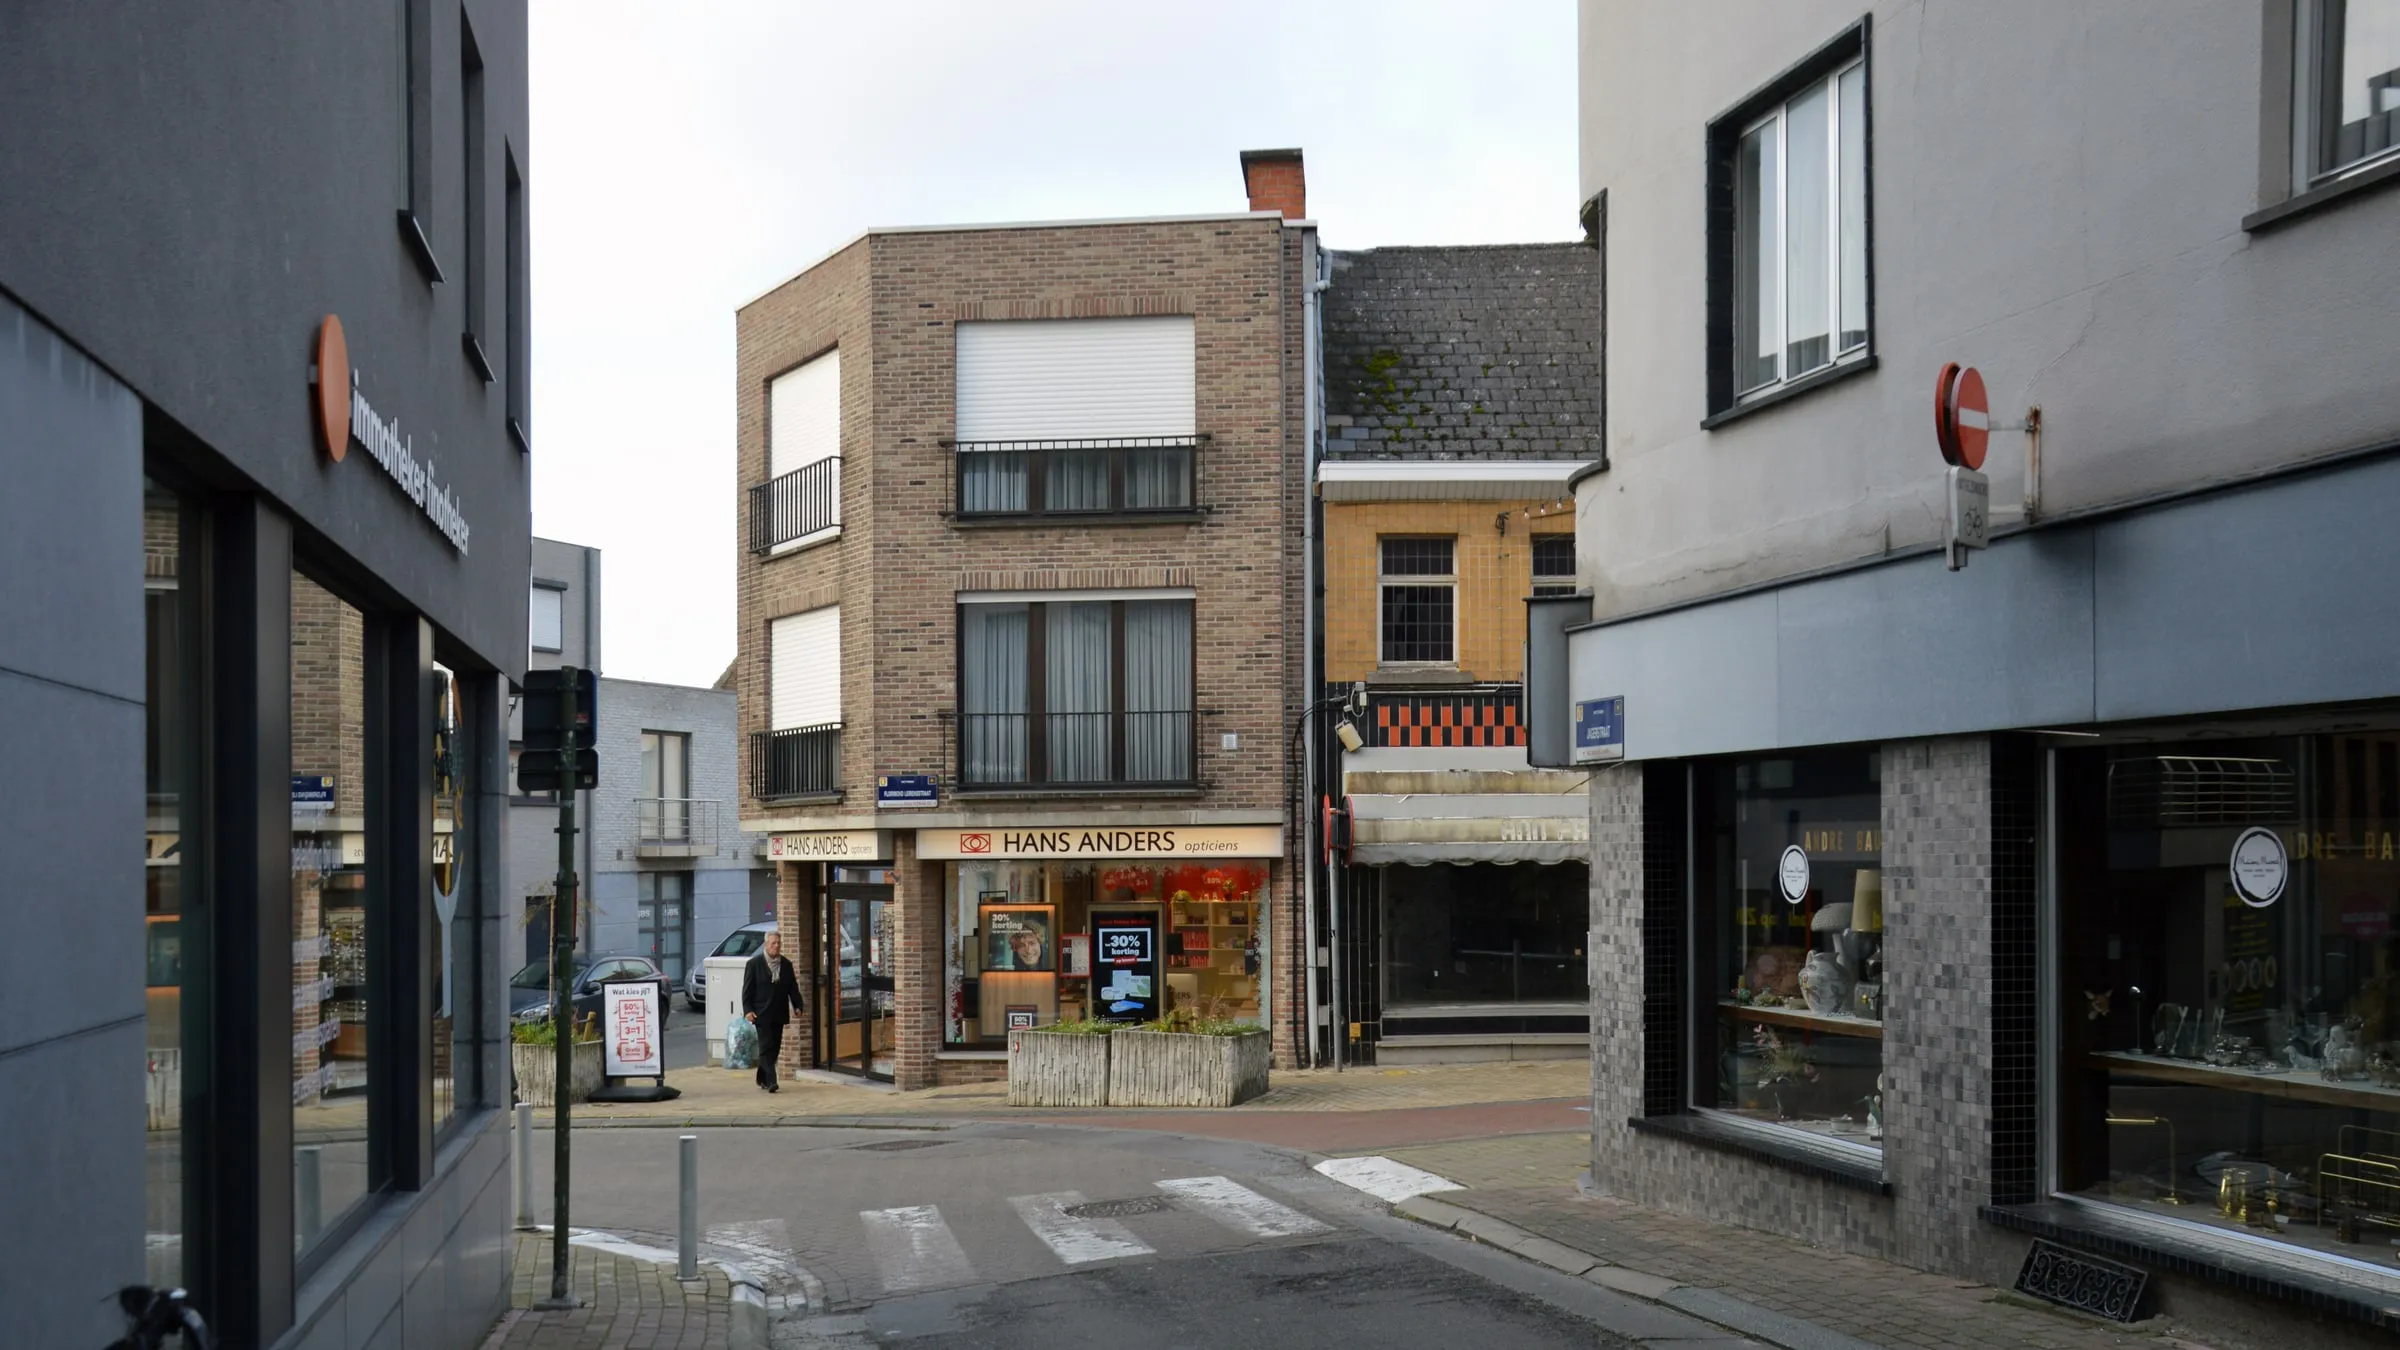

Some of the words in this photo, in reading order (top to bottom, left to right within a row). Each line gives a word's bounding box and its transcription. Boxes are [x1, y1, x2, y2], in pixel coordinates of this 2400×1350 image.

[353, 368, 425, 508] immotheker
[425, 459, 469, 557] finotheker
[786, 837, 810, 855] HANS
[812, 836, 848, 855] ANDERS
[1004, 832, 1070, 852] HANS
[1078, 831, 1175, 852] ANDERS
[1184, 840, 1239, 852] opticiens
[1804, 831, 1843, 851] ANDRE
[992, 921, 1023, 930] korting
[1110, 935, 1141, 947] 30%
[1111, 948, 1140, 956] korting
